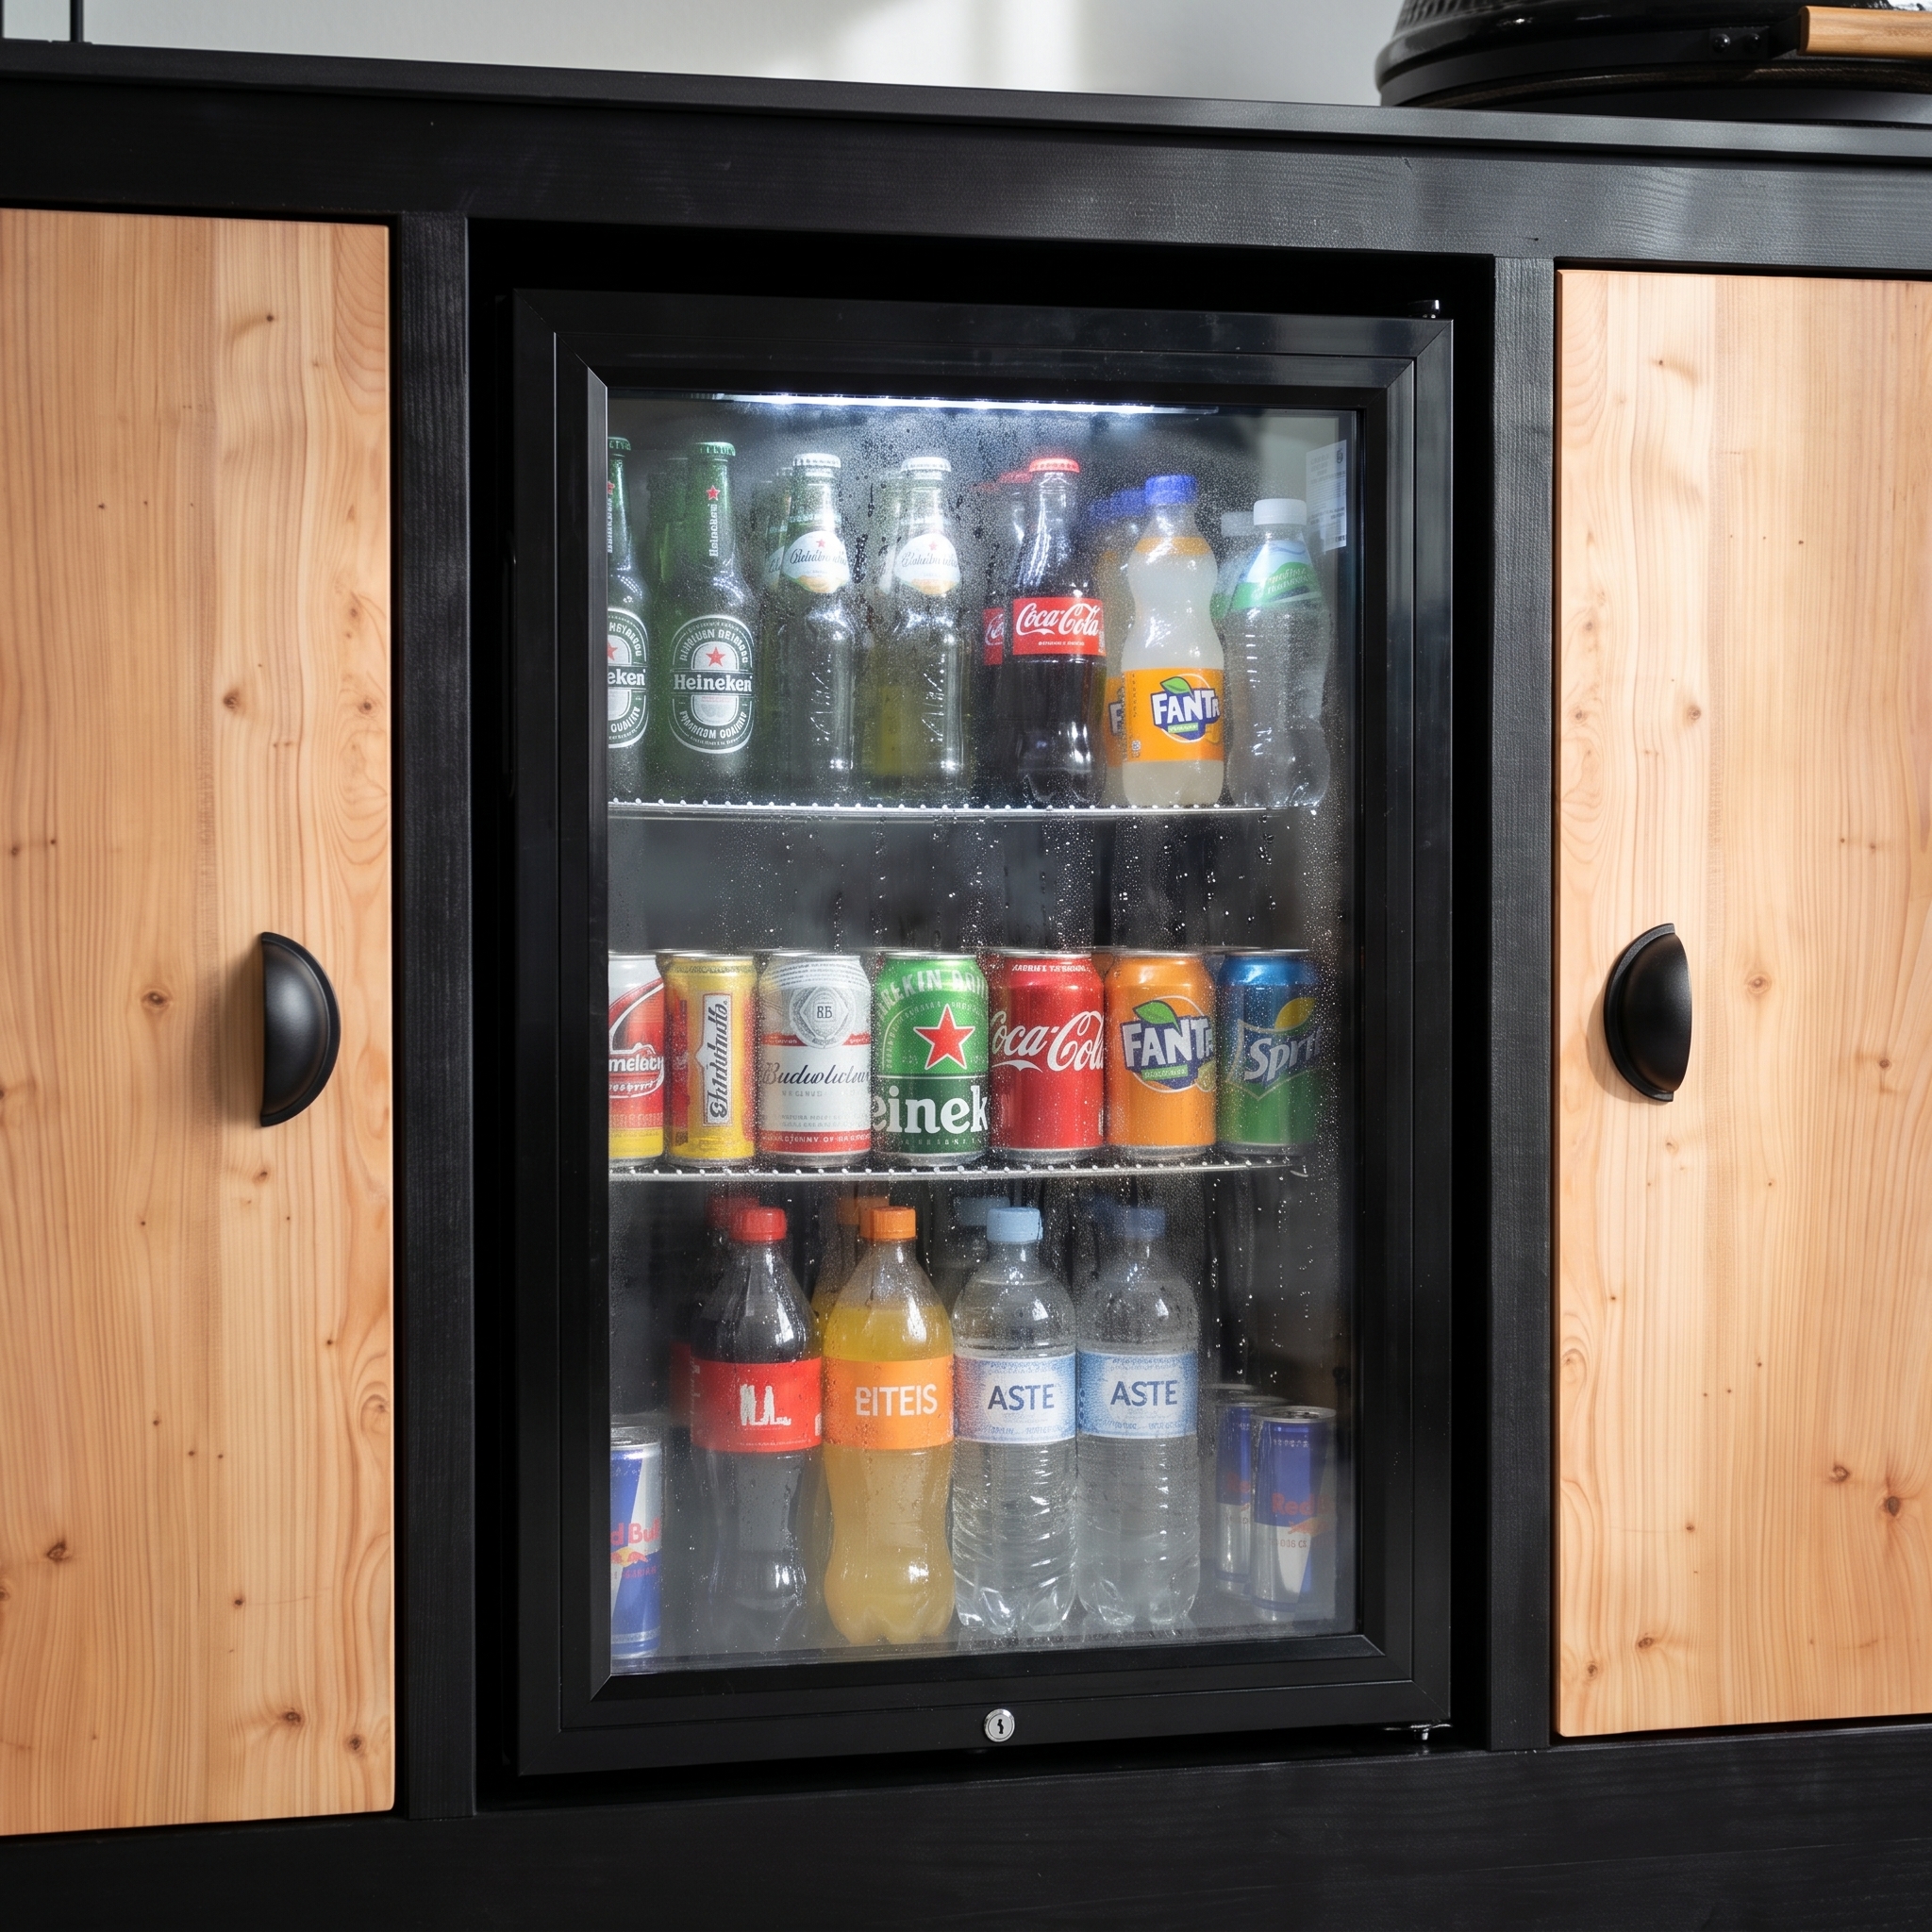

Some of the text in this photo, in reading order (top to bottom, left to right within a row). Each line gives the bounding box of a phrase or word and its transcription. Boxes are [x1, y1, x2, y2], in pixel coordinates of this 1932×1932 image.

[1015, 602, 1101, 637] Coca-Cola
[673, 674, 754, 692] Heineken
[988, 1383, 1055, 1411] ASTE
[1109, 1380, 1177, 1407] ASTE
[1272, 1491, 1315, 1516] Red
